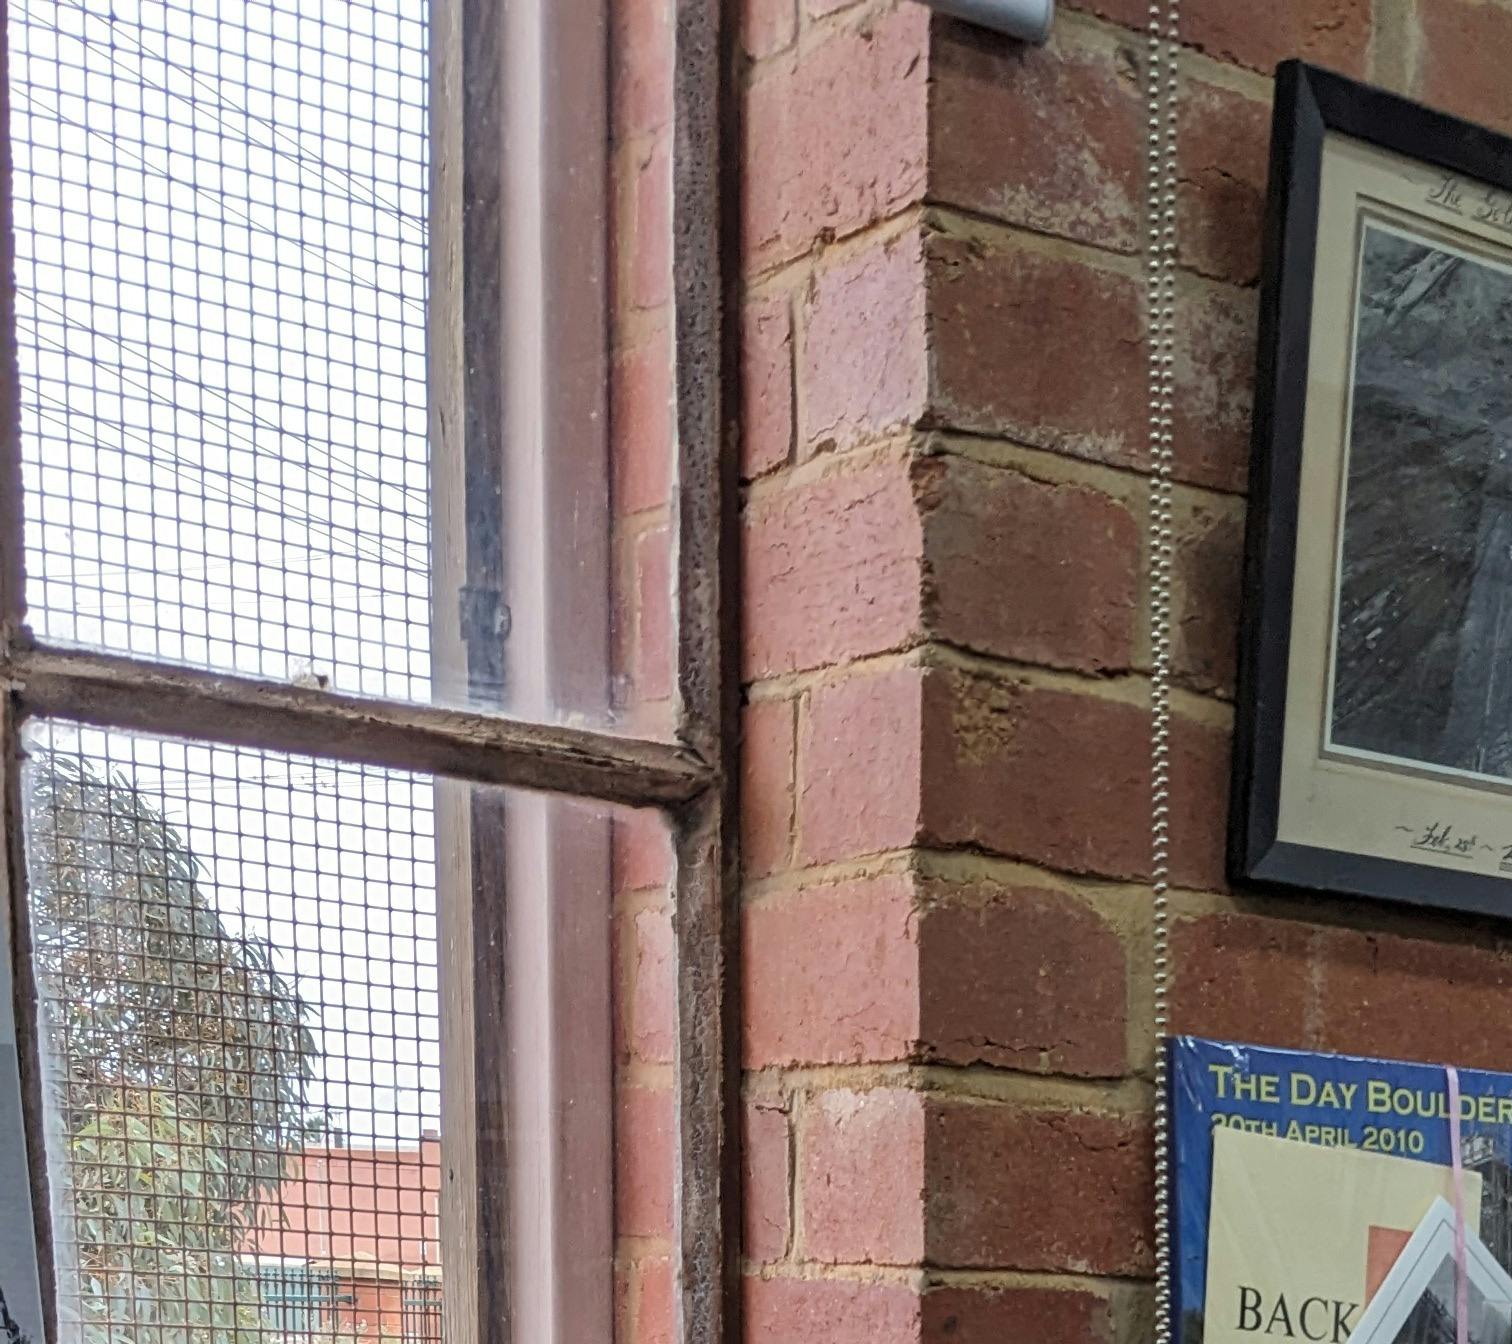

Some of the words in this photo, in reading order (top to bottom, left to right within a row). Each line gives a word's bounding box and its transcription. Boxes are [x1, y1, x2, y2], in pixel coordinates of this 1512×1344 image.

[1429, 172, 1463, 208] The
[1209, 1064, 1280, 1104] THE
[1291, 1072, 1365, 1109] DAY
